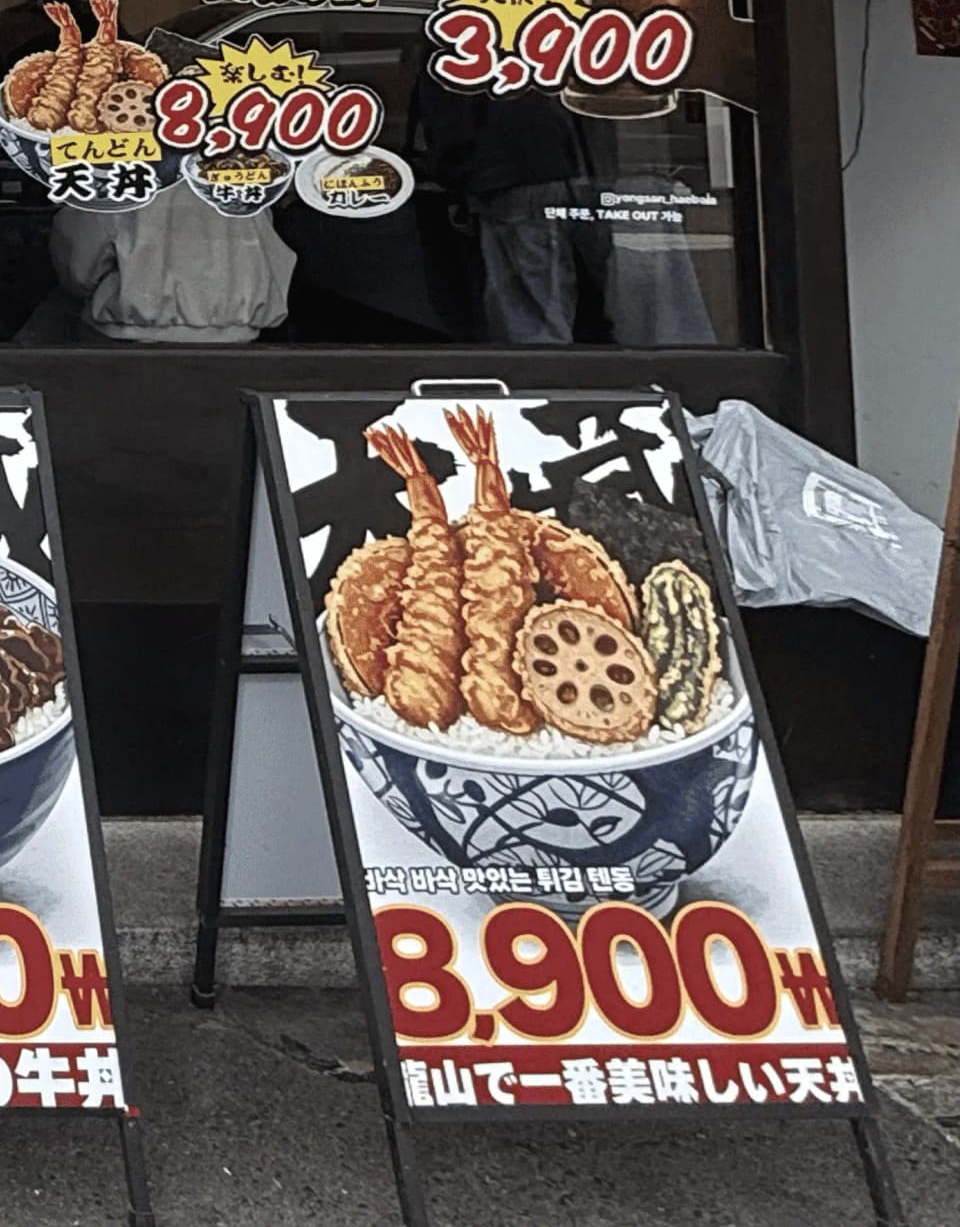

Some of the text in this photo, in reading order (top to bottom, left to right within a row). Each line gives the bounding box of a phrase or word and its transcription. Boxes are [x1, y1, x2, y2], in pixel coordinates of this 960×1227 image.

[434, 7, 692, 95] 3,900
[220, 61, 305, 85] 楽しむ!
[155, 78, 377, 156] 8,900
[55, 136, 157, 160] てんどん
[49, 161, 157, 202] 天丼
[213, 182, 266, 204] 牛丼
[326, 188, 391, 209] カレー
[596, 208, 630, 221] TAKE
[632, 209, 659, 222] OUT
[409, 866, 460, 895] 바삭
[461, 866, 533, 894] 맛있는
[535, 866, 585, 894] 튀김
[586, 866, 636, 894] 텐동
